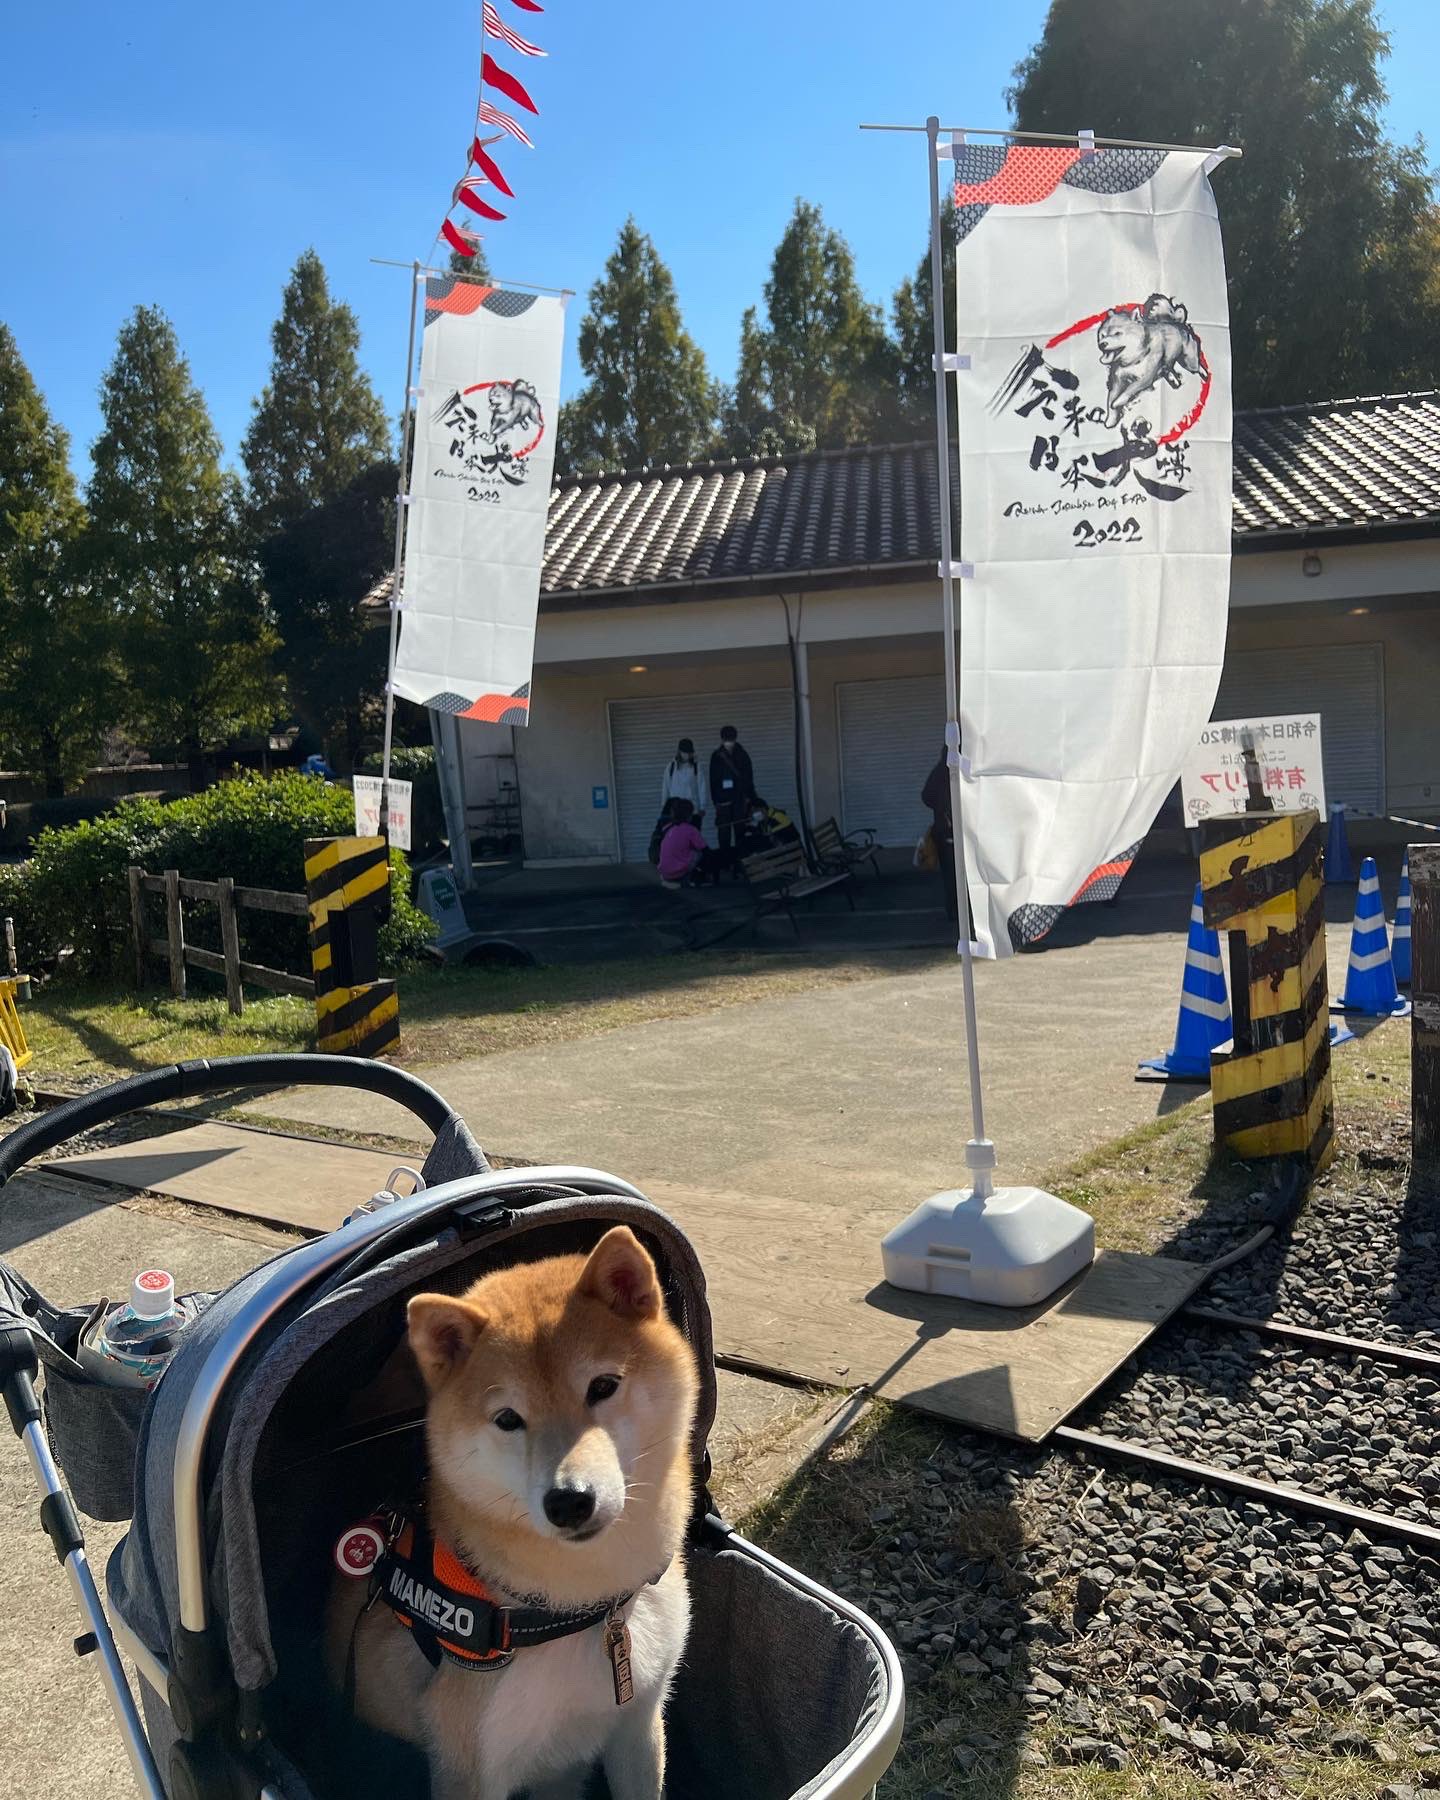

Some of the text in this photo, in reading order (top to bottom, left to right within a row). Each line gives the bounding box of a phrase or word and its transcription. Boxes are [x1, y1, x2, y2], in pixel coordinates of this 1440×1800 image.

[467, 486, 501, 504] 2022
[1097, 496, 1118, 510] Dog
[1072, 516, 1143, 548] 2022
[389, 1567, 475, 1637] MAMEZO
